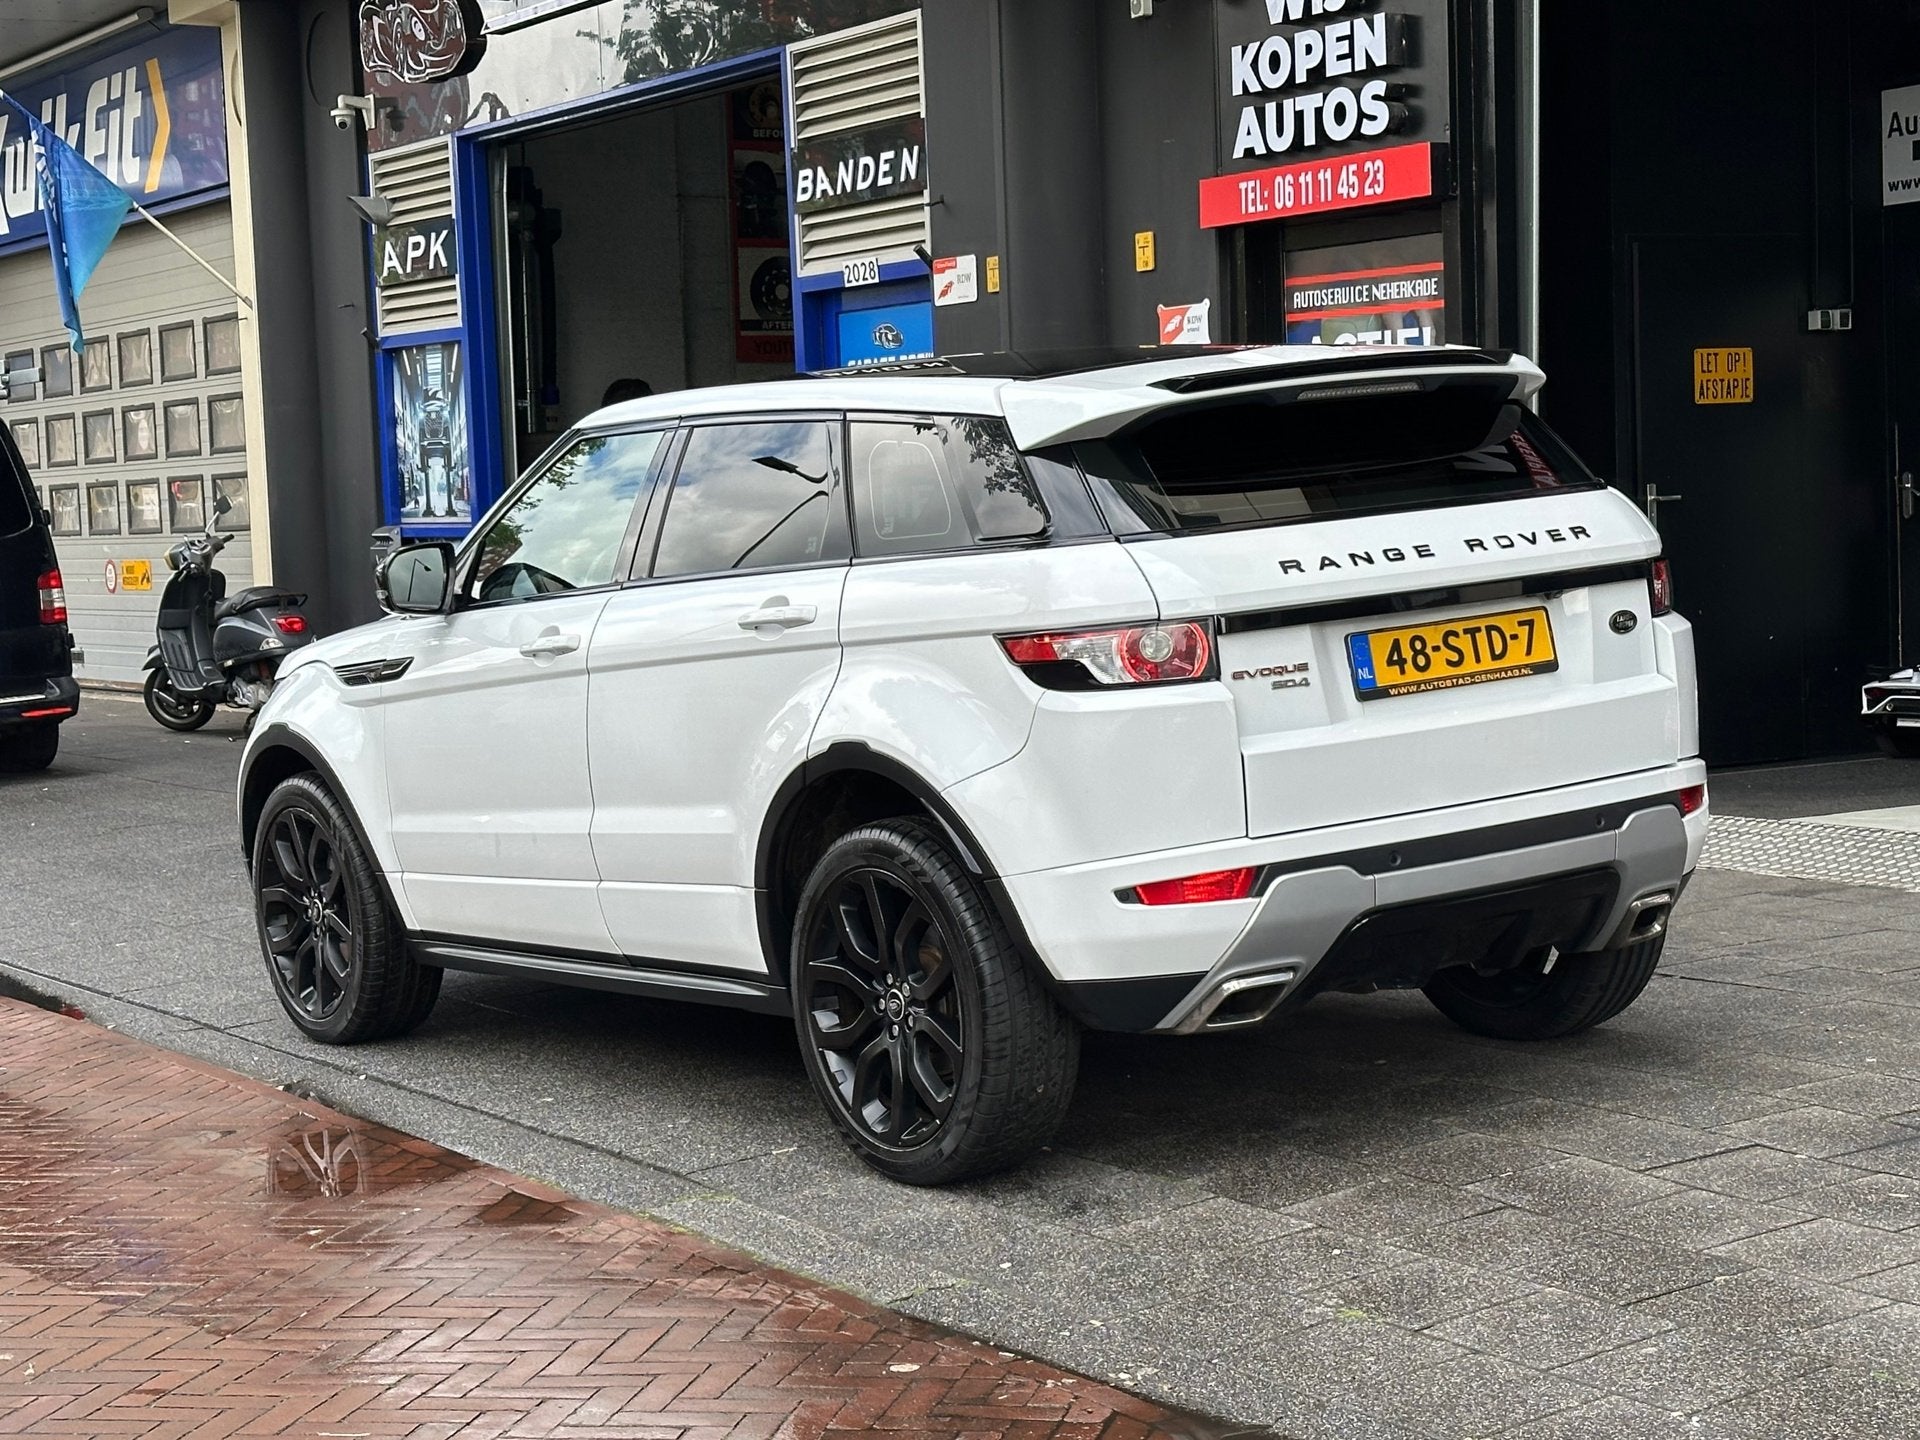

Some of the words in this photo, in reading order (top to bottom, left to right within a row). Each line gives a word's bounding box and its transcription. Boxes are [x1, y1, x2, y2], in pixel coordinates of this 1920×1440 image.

[1231, 12, 1387, 96] KOPEN
[1232, 80, 1390, 159] AUTOS
[1887, 111, 1920, 139] Au
[752, 128, 784, 138] BEFO
[796, 145, 919, 203] BANDEN
[1238, 179, 1268, 215] TEL:
[1274, 173, 1294, 210] 06
[1299, 171, 1313, 206] 11
[1318, 167, 1332, 202] 11
[1337, 163, 1359, 199] 45
[1363, 159, 1385, 197] 23
[382, 229, 449, 277] APK
[844, 259, 877, 284] 2028
[1372, 277, 1438, 301] NEHERKADE
[1700, 352, 1719, 374] LET
[1727, 352, 1746, 373] OP!
[1699, 378, 1751, 400] AFSTAPJE
[1278, 544, 1436, 575] RANGE
[1463, 525, 1592, 553] ROVER
[1386, 618, 1535, 676] 48-STD-7
[1232, 662, 1309, 680] EVOQUE
[1271, 677, 1311, 690] SD4
[1357, 666, 1374, 680] NL
